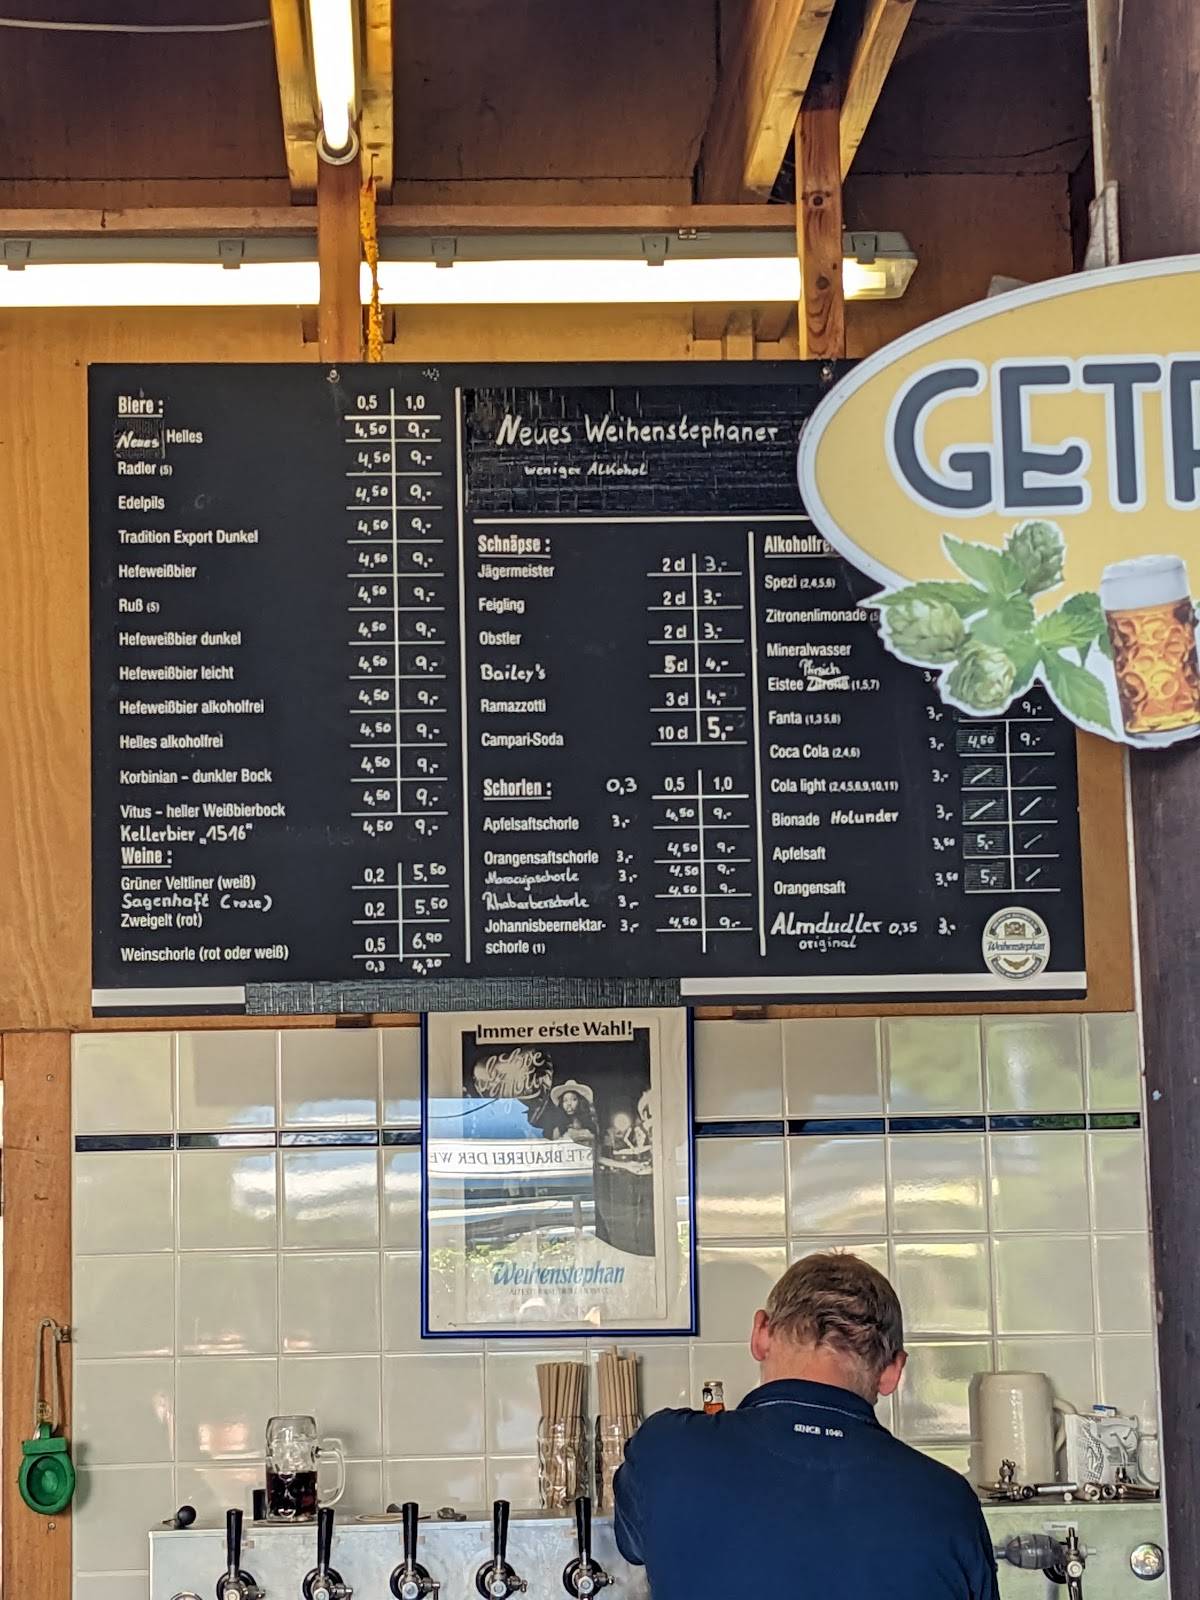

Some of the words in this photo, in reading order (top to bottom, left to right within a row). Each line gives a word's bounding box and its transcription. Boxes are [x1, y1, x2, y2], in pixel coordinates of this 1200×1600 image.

[358, 395, 377, 410] 0,5
[406, 395, 424, 411] 1,0
[167, 429, 203, 443] Helles
[496, 414, 572, 446] Neues
[585, 413, 778, 448] Weihenstephaner
[118, 461, 156, 474] Radler
[524, 465, 580, 479] weniger
[119, 496, 164, 512] Edelpils
[118, 530, 170, 543] Tradition
[174, 530, 213, 546] Export
[216, 530, 258, 543] Dunkel
[764, 535, 833, 553] Alkoholfre
[119, 564, 196, 578] Hefeweißbier
[478, 564, 554, 580] Jägermeister
[765, 575, 796, 591] Spezi
[479, 598, 524, 613] Feigling
[766, 609, 866, 622] Zitronenlimonade
[119, 632, 197, 645] Hefeweißbier
[201, 631, 241, 645] dunkel
[480, 631, 521, 645] Obstler
[767, 643, 851, 656] Mineralwasser
[120, 666, 198, 680] Hefeweißbier
[201, 666, 233, 679] leicht
[768, 677, 803, 691] Eistee
[120, 700, 198, 714] Hefeweißbier
[202, 699, 264, 713] alkoholfrei
[481, 699, 546, 712] Ramazzotti
[769, 711, 802, 724] Fanta
[120, 735, 157, 748] Helles
[160, 734, 223, 748] alkoholfrei
[481, 732, 563, 748] Campari-Soda
[770, 745, 800, 758] Coca
[803, 744, 829, 758] Cola
[120, 770, 177, 784] Korbinian
[193, 769, 237, 783] dunkler
[241, 768, 272, 782] Bock
[665, 777, 684, 792] 0,5
[714, 777, 732, 792] 1,0
[771, 779, 797, 792] Cola
[800, 778, 826, 794] light
[120, 805, 151, 818] Vitus
[167, 804, 199, 817] heller
[203, 803, 285, 817] Weißbierbock
[484, 817, 579, 833] Apfelsaftschorle
[772, 813, 820, 826] Bionade
[120, 825, 195, 842] Kellerbier
[484, 850, 598, 867] Orangensaftschorle
[773, 846, 825, 863] Apfelsaft
[121, 877, 162, 890] Grüner
[165, 876, 214, 890] Veltliner
[365, 868, 384, 883] 0,2
[774, 880, 845, 897] Orangensaft
[122, 893, 208, 912] Sagenhaft
[121, 913, 172, 929] Zweigelt
[365, 902, 384, 918] 0,2
[771, 912, 882, 938] Almdudler
[121, 947, 195, 961] Weinschorle
[224, 946, 251, 960] oder
[365, 938, 385, 953] 0,5
[486, 940, 529, 954] schorle
[799, 935, 856, 952] original
[477, 1024, 533, 1039] Immer
[539, 1022, 580, 1037] erste
[583, 1020, 632, 1037] Wahl!
[494, 1261, 624, 1286] Weihenstephan
[793, 1424, 821, 1435] SINCE
